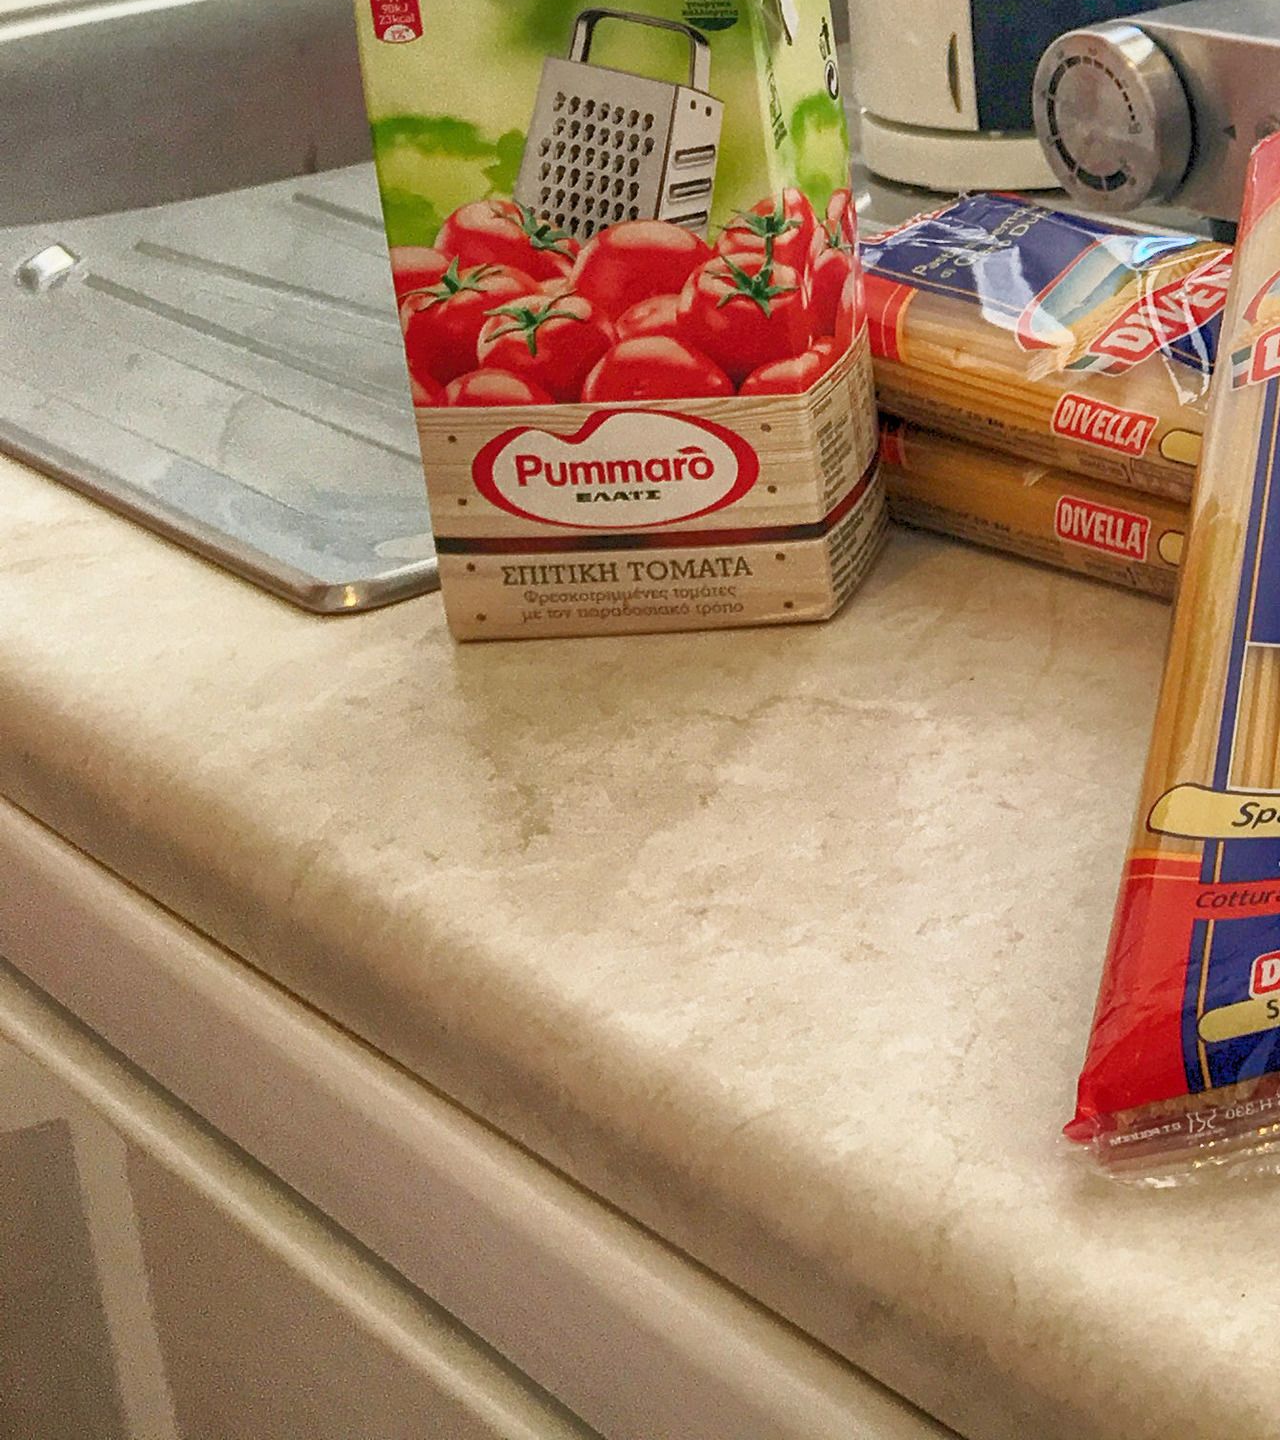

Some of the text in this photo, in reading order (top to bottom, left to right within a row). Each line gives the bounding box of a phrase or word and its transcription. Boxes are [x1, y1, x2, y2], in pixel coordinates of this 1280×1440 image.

[1056, 398, 1148, 451] DIVELLA
[1059, 502, 1147, 555] DIVELLA
[501, 555, 754, 586] ΣΠΙΤΙΚΗ ΤΟΜΑΤΑ
